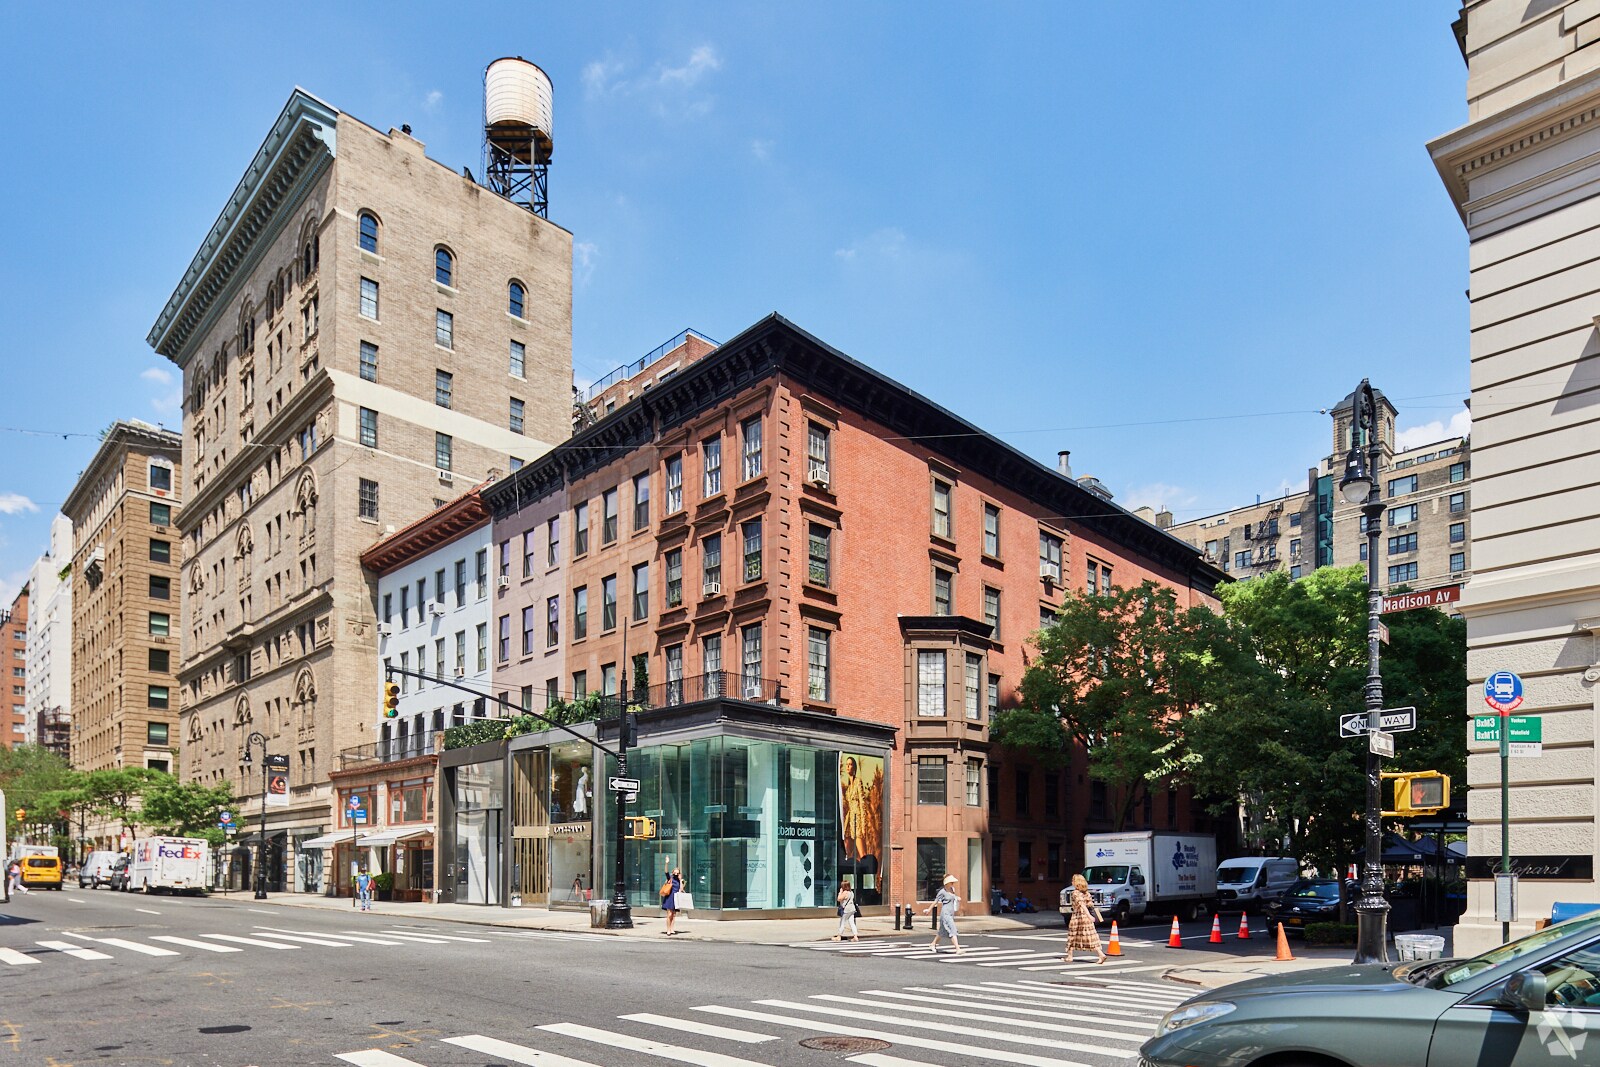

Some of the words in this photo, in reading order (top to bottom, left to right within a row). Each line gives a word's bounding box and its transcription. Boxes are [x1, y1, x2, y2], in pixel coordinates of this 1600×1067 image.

[1383, 595, 1431, 612] Madison
[1436, 591, 1451, 603] Av
[1350, 720, 1365, 730] ON
[1384, 715, 1407, 726] WAY
[1476, 717, 1495, 727] BxM3
[1476, 730, 1499, 740] BxM11
[159, 846, 202, 859] FedEx
[1487, 856, 1569, 879] Chopard
